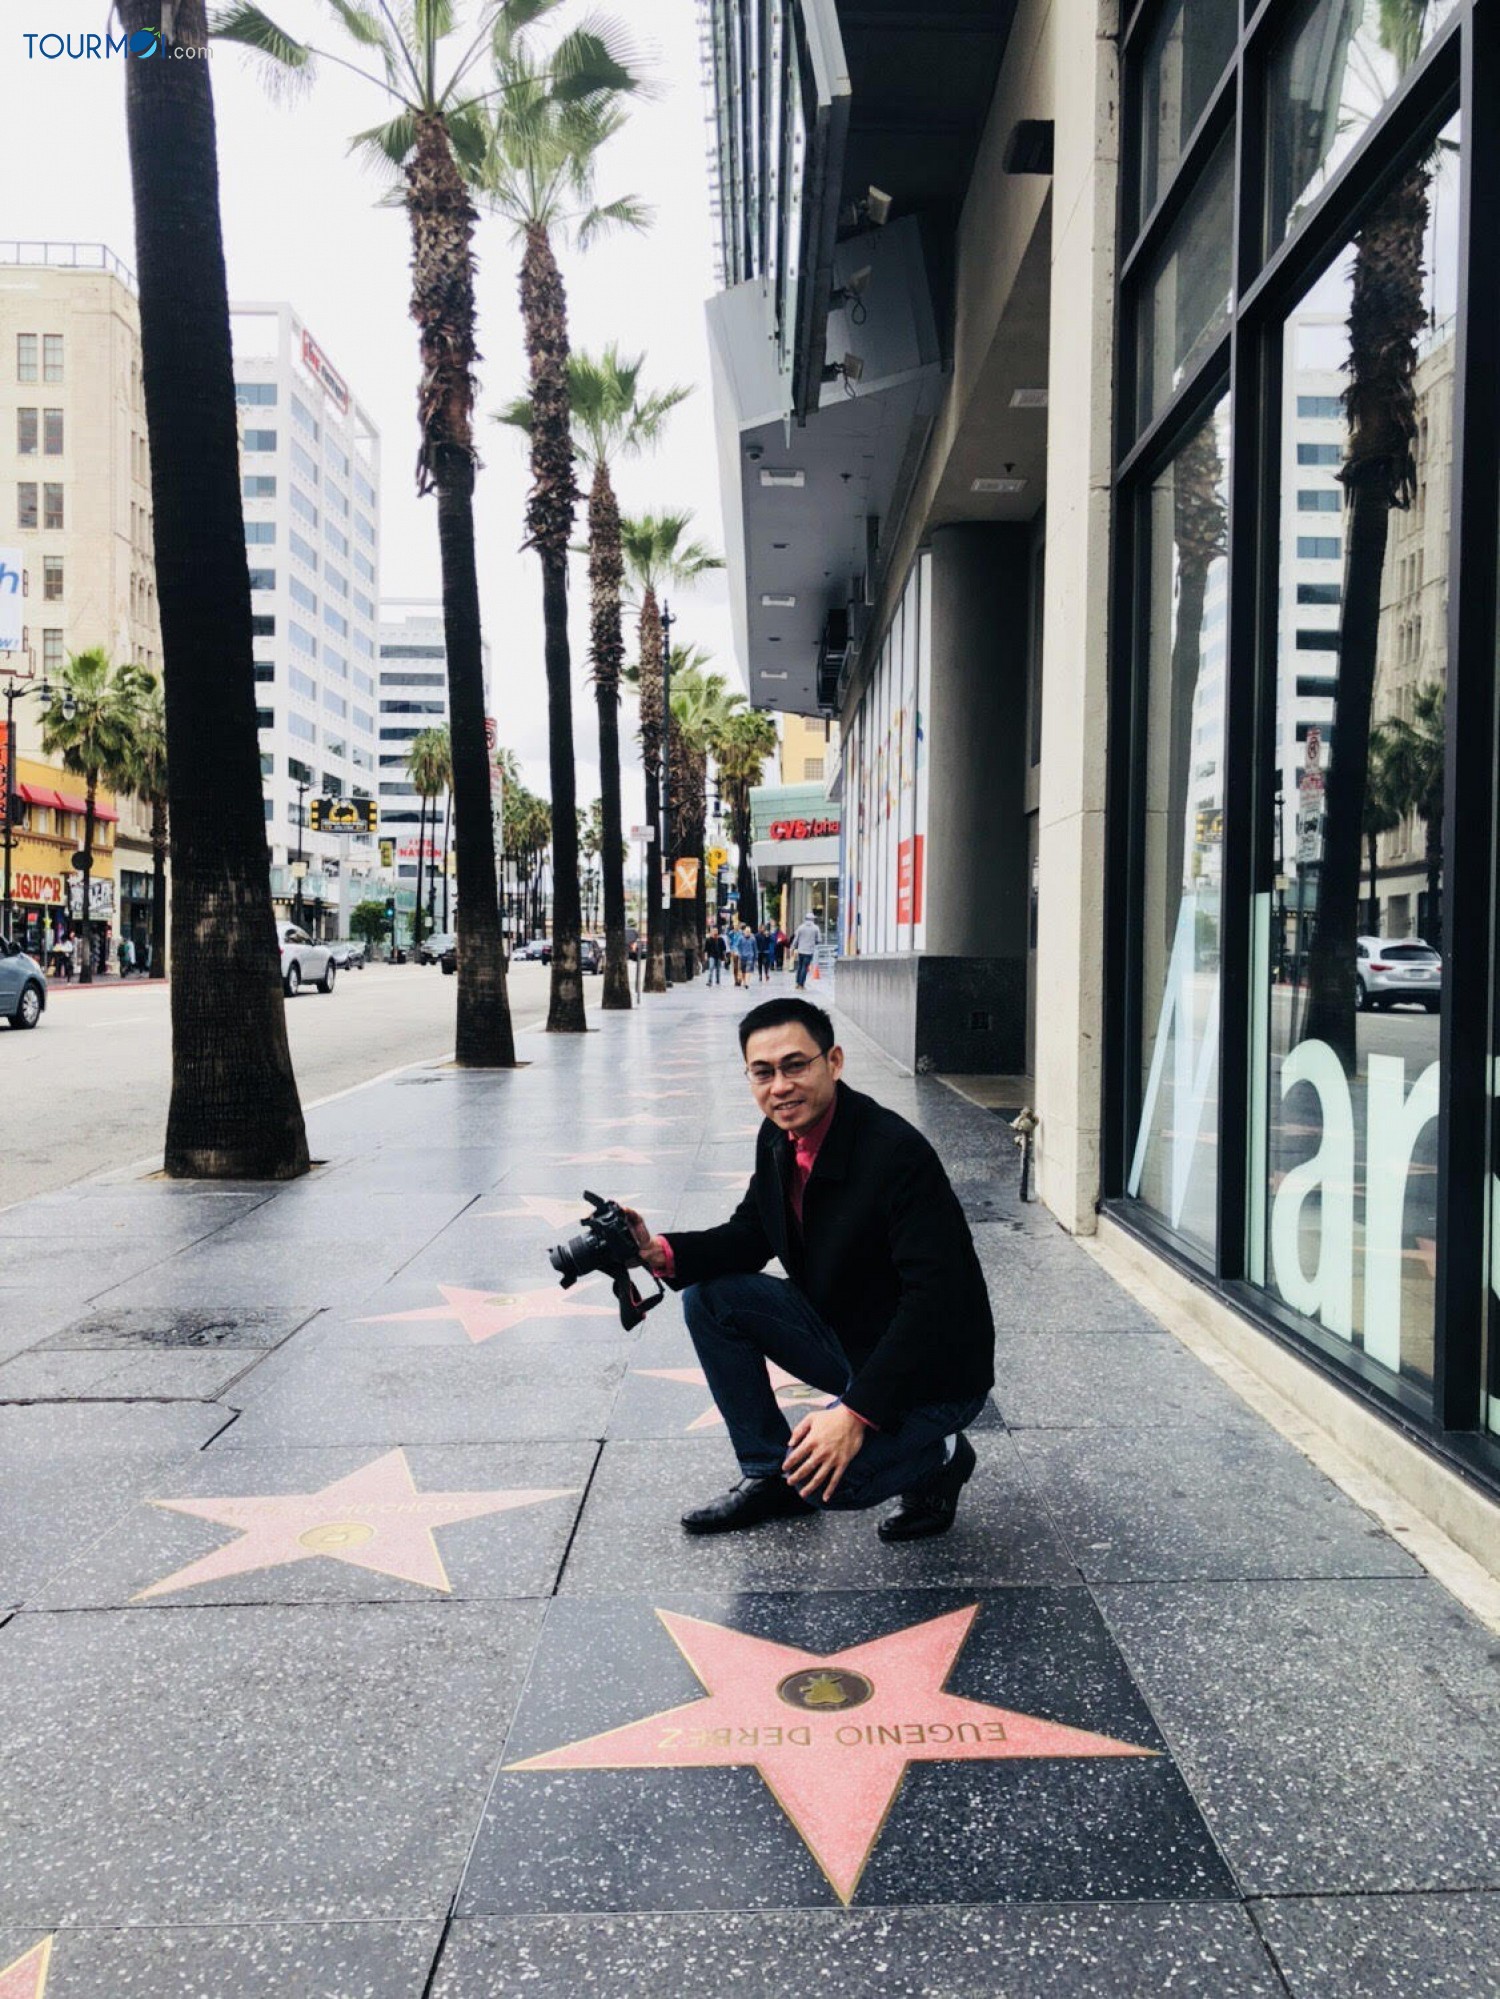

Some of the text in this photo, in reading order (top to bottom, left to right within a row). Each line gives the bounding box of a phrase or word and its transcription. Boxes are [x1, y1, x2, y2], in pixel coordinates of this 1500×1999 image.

[398, 847, 442, 857] NAON
[657, 1721, 1007, 1748] EUGENIO DERBEZ
